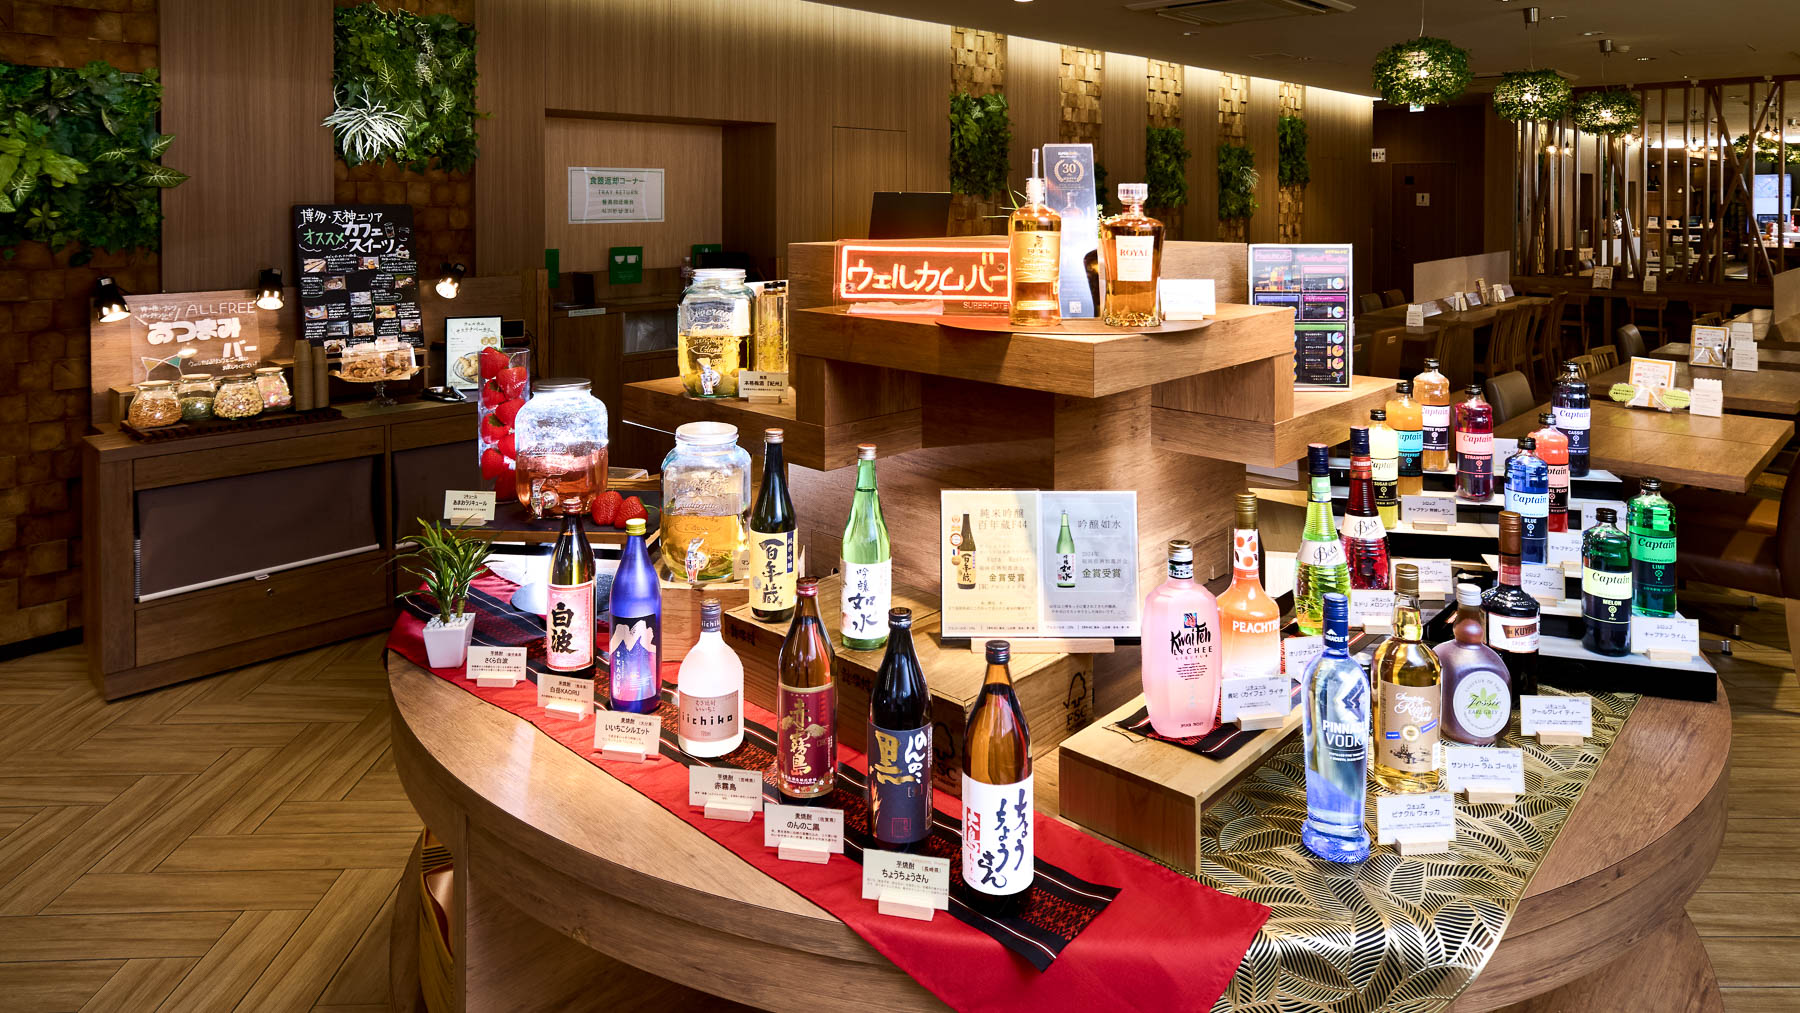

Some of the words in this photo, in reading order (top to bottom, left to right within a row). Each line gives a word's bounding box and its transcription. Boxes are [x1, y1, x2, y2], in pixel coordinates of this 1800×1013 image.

[1062, 163, 1077, 173] 30
[590, 176, 646, 185] 食器返却コーナー
[301, 208, 383, 223] 博多・天神エリア
[343, 221, 383, 238] カフェ
[303, 229, 345, 245] オススメ
[349, 238, 395, 253] スイーツ
[847, 252, 1007, 293] ウェルカムバー
[186, 303, 256, 318] ALLFREE
[963, 302, 1008, 312] SUPERHOTE
[1560, 410, 1589, 419] Captain
[1399, 433, 1422, 442] aptain
[1463, 434, 1492, 445] Captain
[1513, 493, 1547, 505] Captain
[1638, 537, 1675, 550] Captain
[989, 574, 1025, 582] 金賞受賞
[1082, 568, 1121, 579] 金賞受賞
[1592, 571, 1630, 585] Captain
[551, 602, 578, 655] 白波
[1232, 620, 1280, 634] PEACHTR
[1173, 646, 1213, 655] LYCHEE
[682, 711, 733, 726] iichiko
[1066, 705, 1088, 726] FSC
[605, 724, 650, 735] いいちこシルエット
[787, 821, 820, 831] のんのこ黒
[882, 868, 929, 884] ちょうちょうさん
